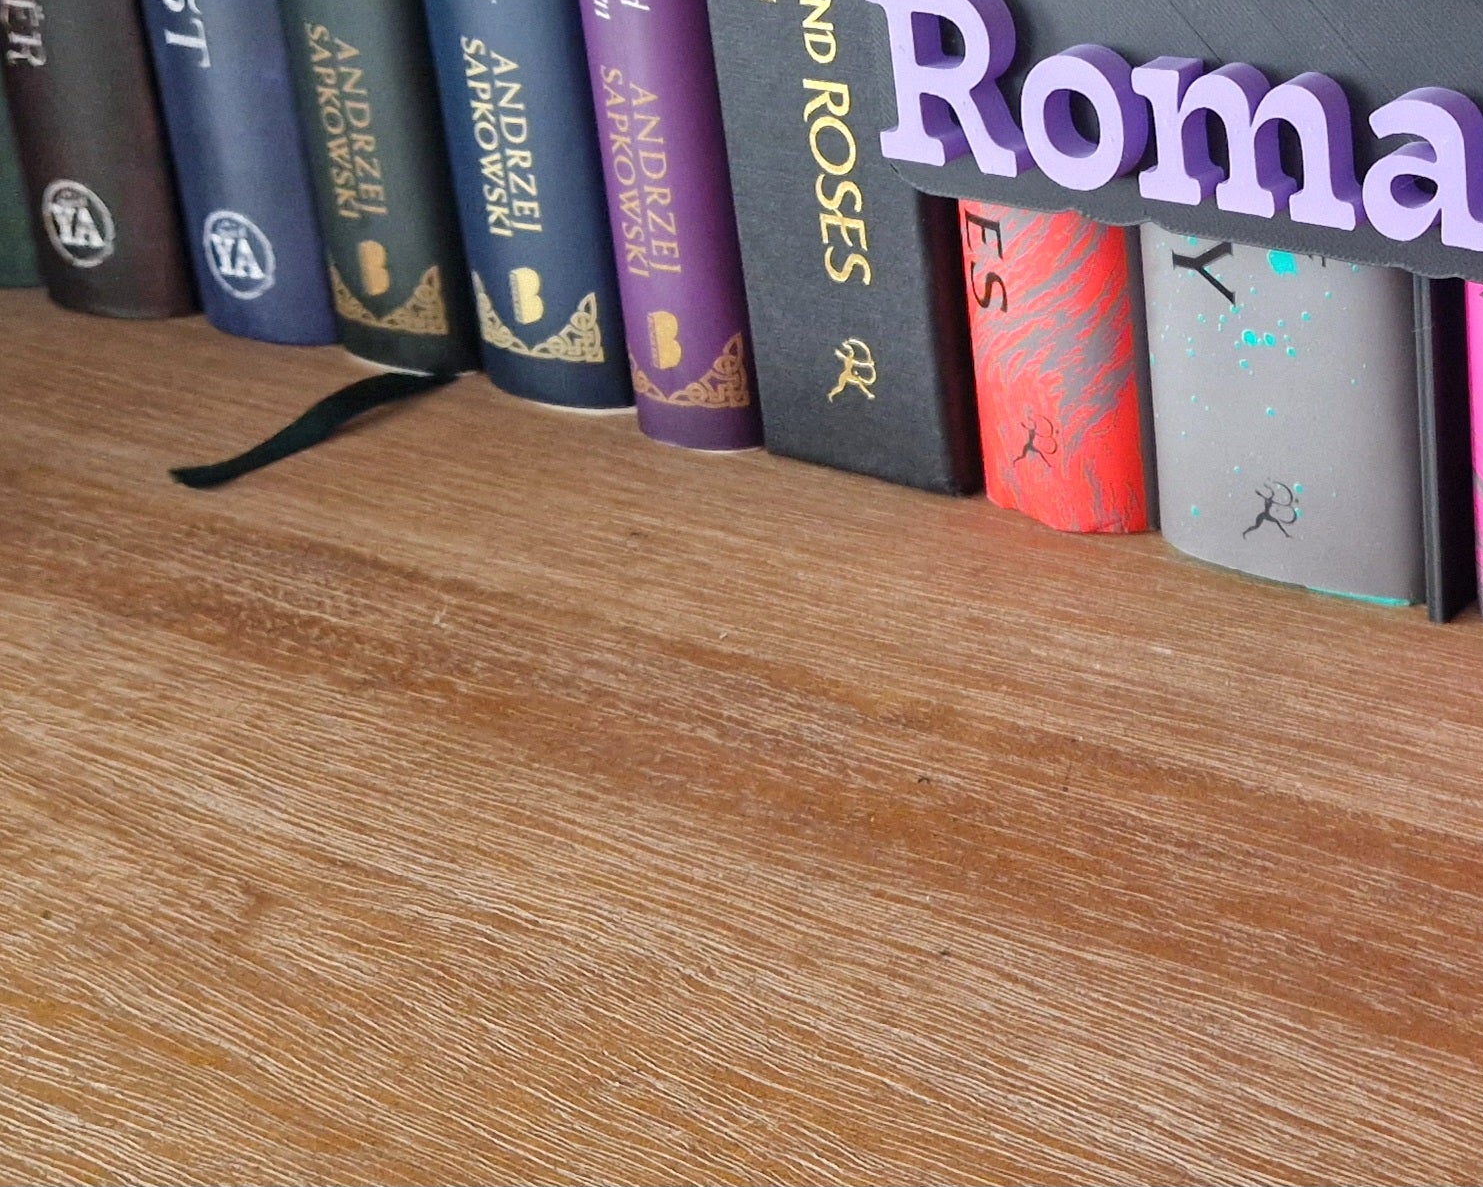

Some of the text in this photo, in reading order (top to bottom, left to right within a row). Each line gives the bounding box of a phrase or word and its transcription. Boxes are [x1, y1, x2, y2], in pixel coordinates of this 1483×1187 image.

[304, 22, 362, 219] SAPKOWSKI
[334, 36, 388, 215] ANDRZEJ
[460, 35, 514, 238] SAPKOWSKI
[491, 49, 543, 232] ANDRZEJ
[601, 65, 651, 278] SAPKOWSKI
[629, 82, 682, 274] ANDRZEJ
[802, 77, 873, 286] ROSES
